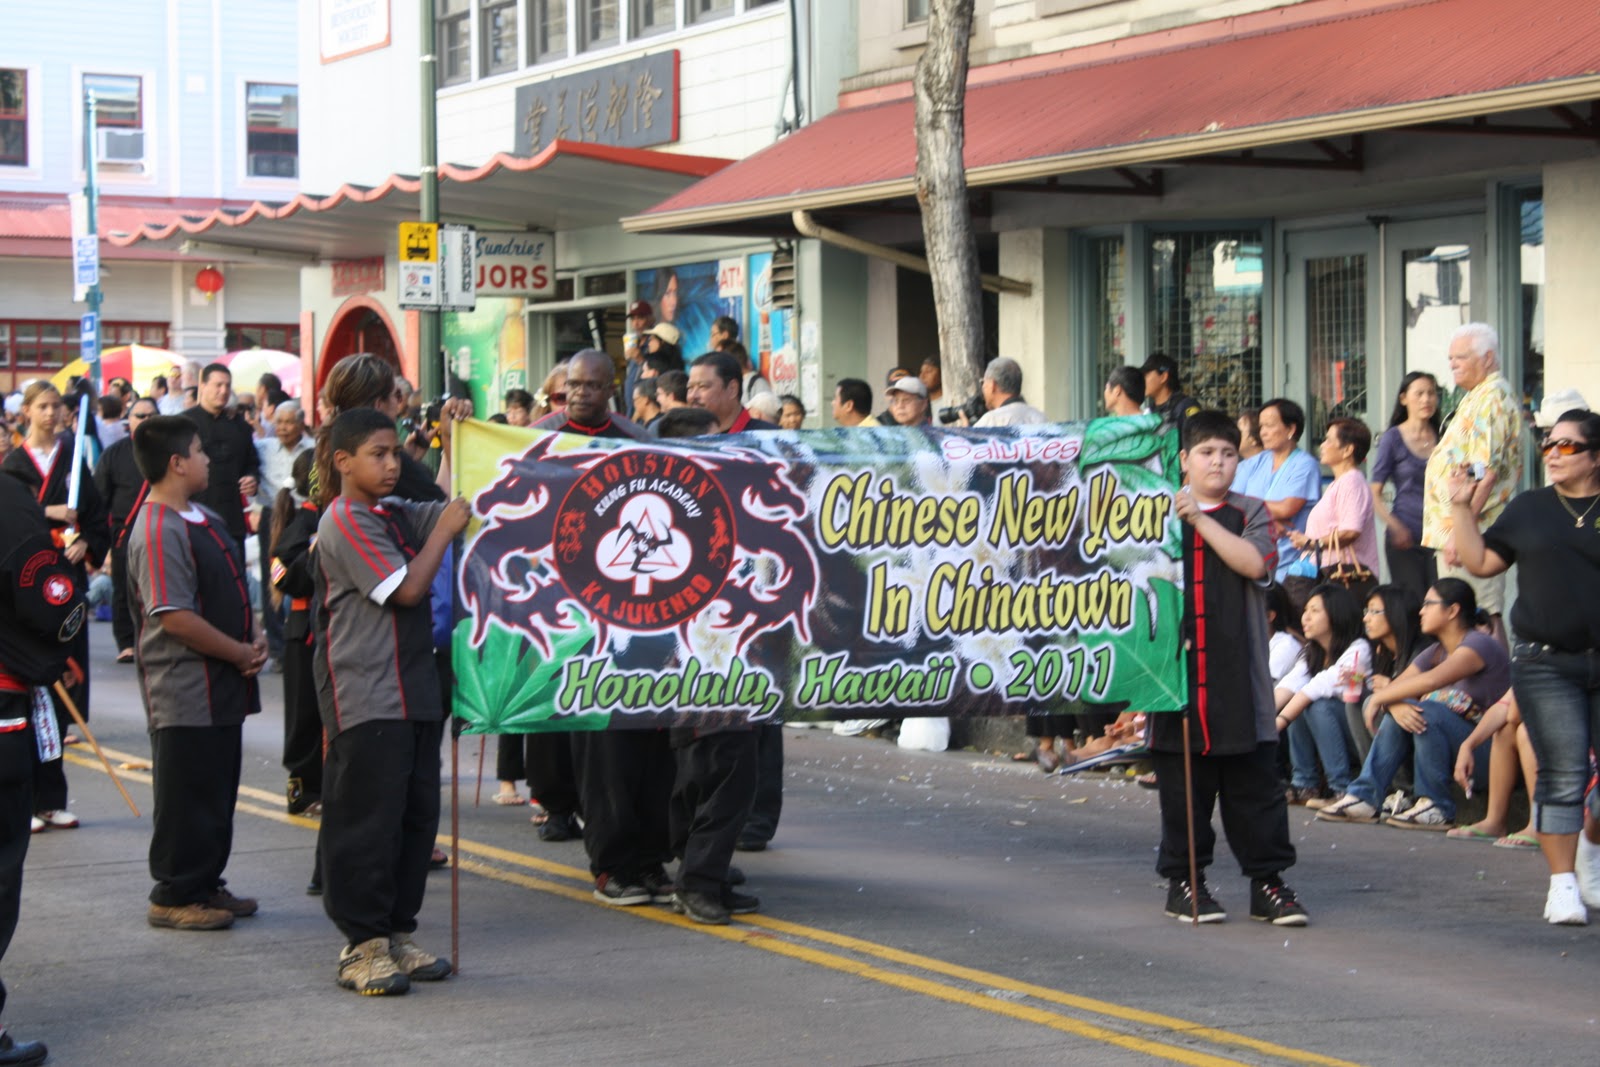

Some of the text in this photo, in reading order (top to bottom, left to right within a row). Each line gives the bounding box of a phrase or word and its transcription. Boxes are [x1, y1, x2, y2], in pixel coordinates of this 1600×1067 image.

[475, 236, 545, 261] Sundries
[943, 437, 1082, 461] Salutes
[580, 454, 714, 499] HOUSTON
[594, 478, 703, 519] KUNG FU ACADEMY
[819, 469, 1172, 557] Chinese New Year
[580, 573, 713, 625] KAJUKENBO
[867, 559, 1133, 638] In Chinatown
[558, 646, 1113, 716] Honolulu, Hawaii 2011
